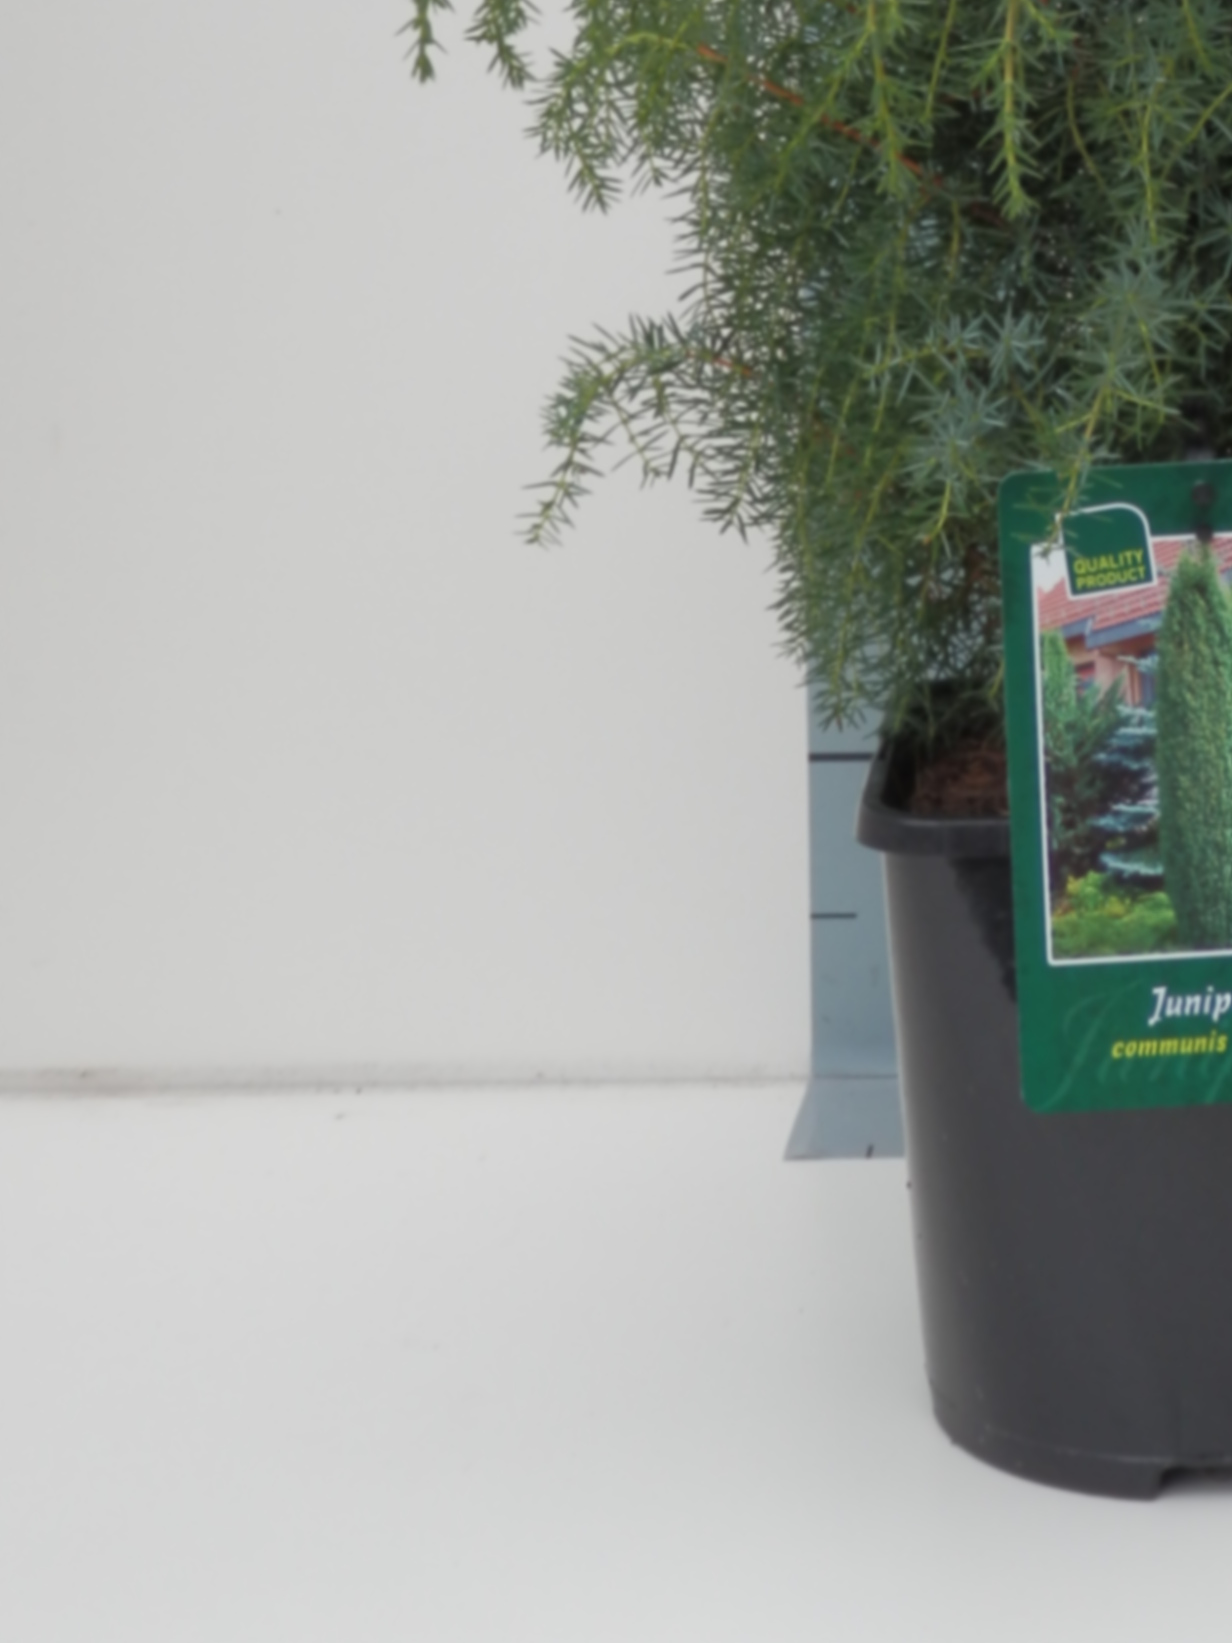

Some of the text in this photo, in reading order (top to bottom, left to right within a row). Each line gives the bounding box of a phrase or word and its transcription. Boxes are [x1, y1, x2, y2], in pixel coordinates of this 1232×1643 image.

[1073, 548, 1143, 575] QUALITY
[1076, 565, 1145, 590] PRODUCT
[1111, 1029, 1228, 1058] communis
